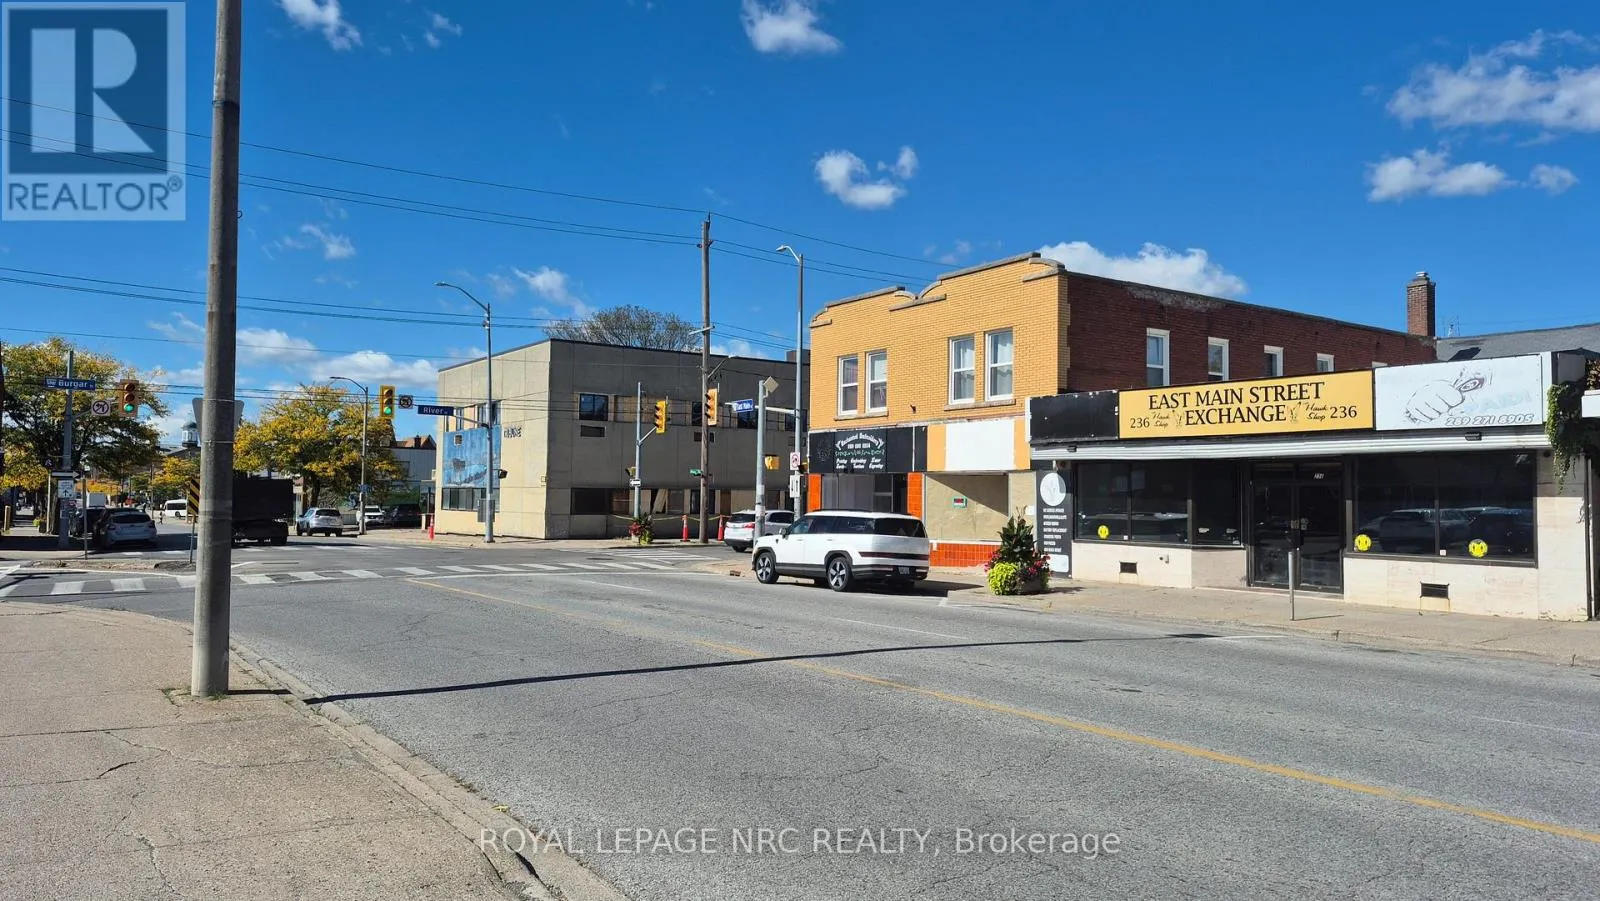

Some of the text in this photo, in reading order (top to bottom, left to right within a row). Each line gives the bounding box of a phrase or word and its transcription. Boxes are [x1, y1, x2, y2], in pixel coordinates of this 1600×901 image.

[1148, 382, 1325, 410] EAST MAIN STREET
[423, 406, 444, 414] River
[1185, 404, 1287, 426] EXCHANGE
[1307, 412, 1326, 421] Shop
[1329, 405, 1358, 419] 236
[1130, 417, 1150, 429] 236
